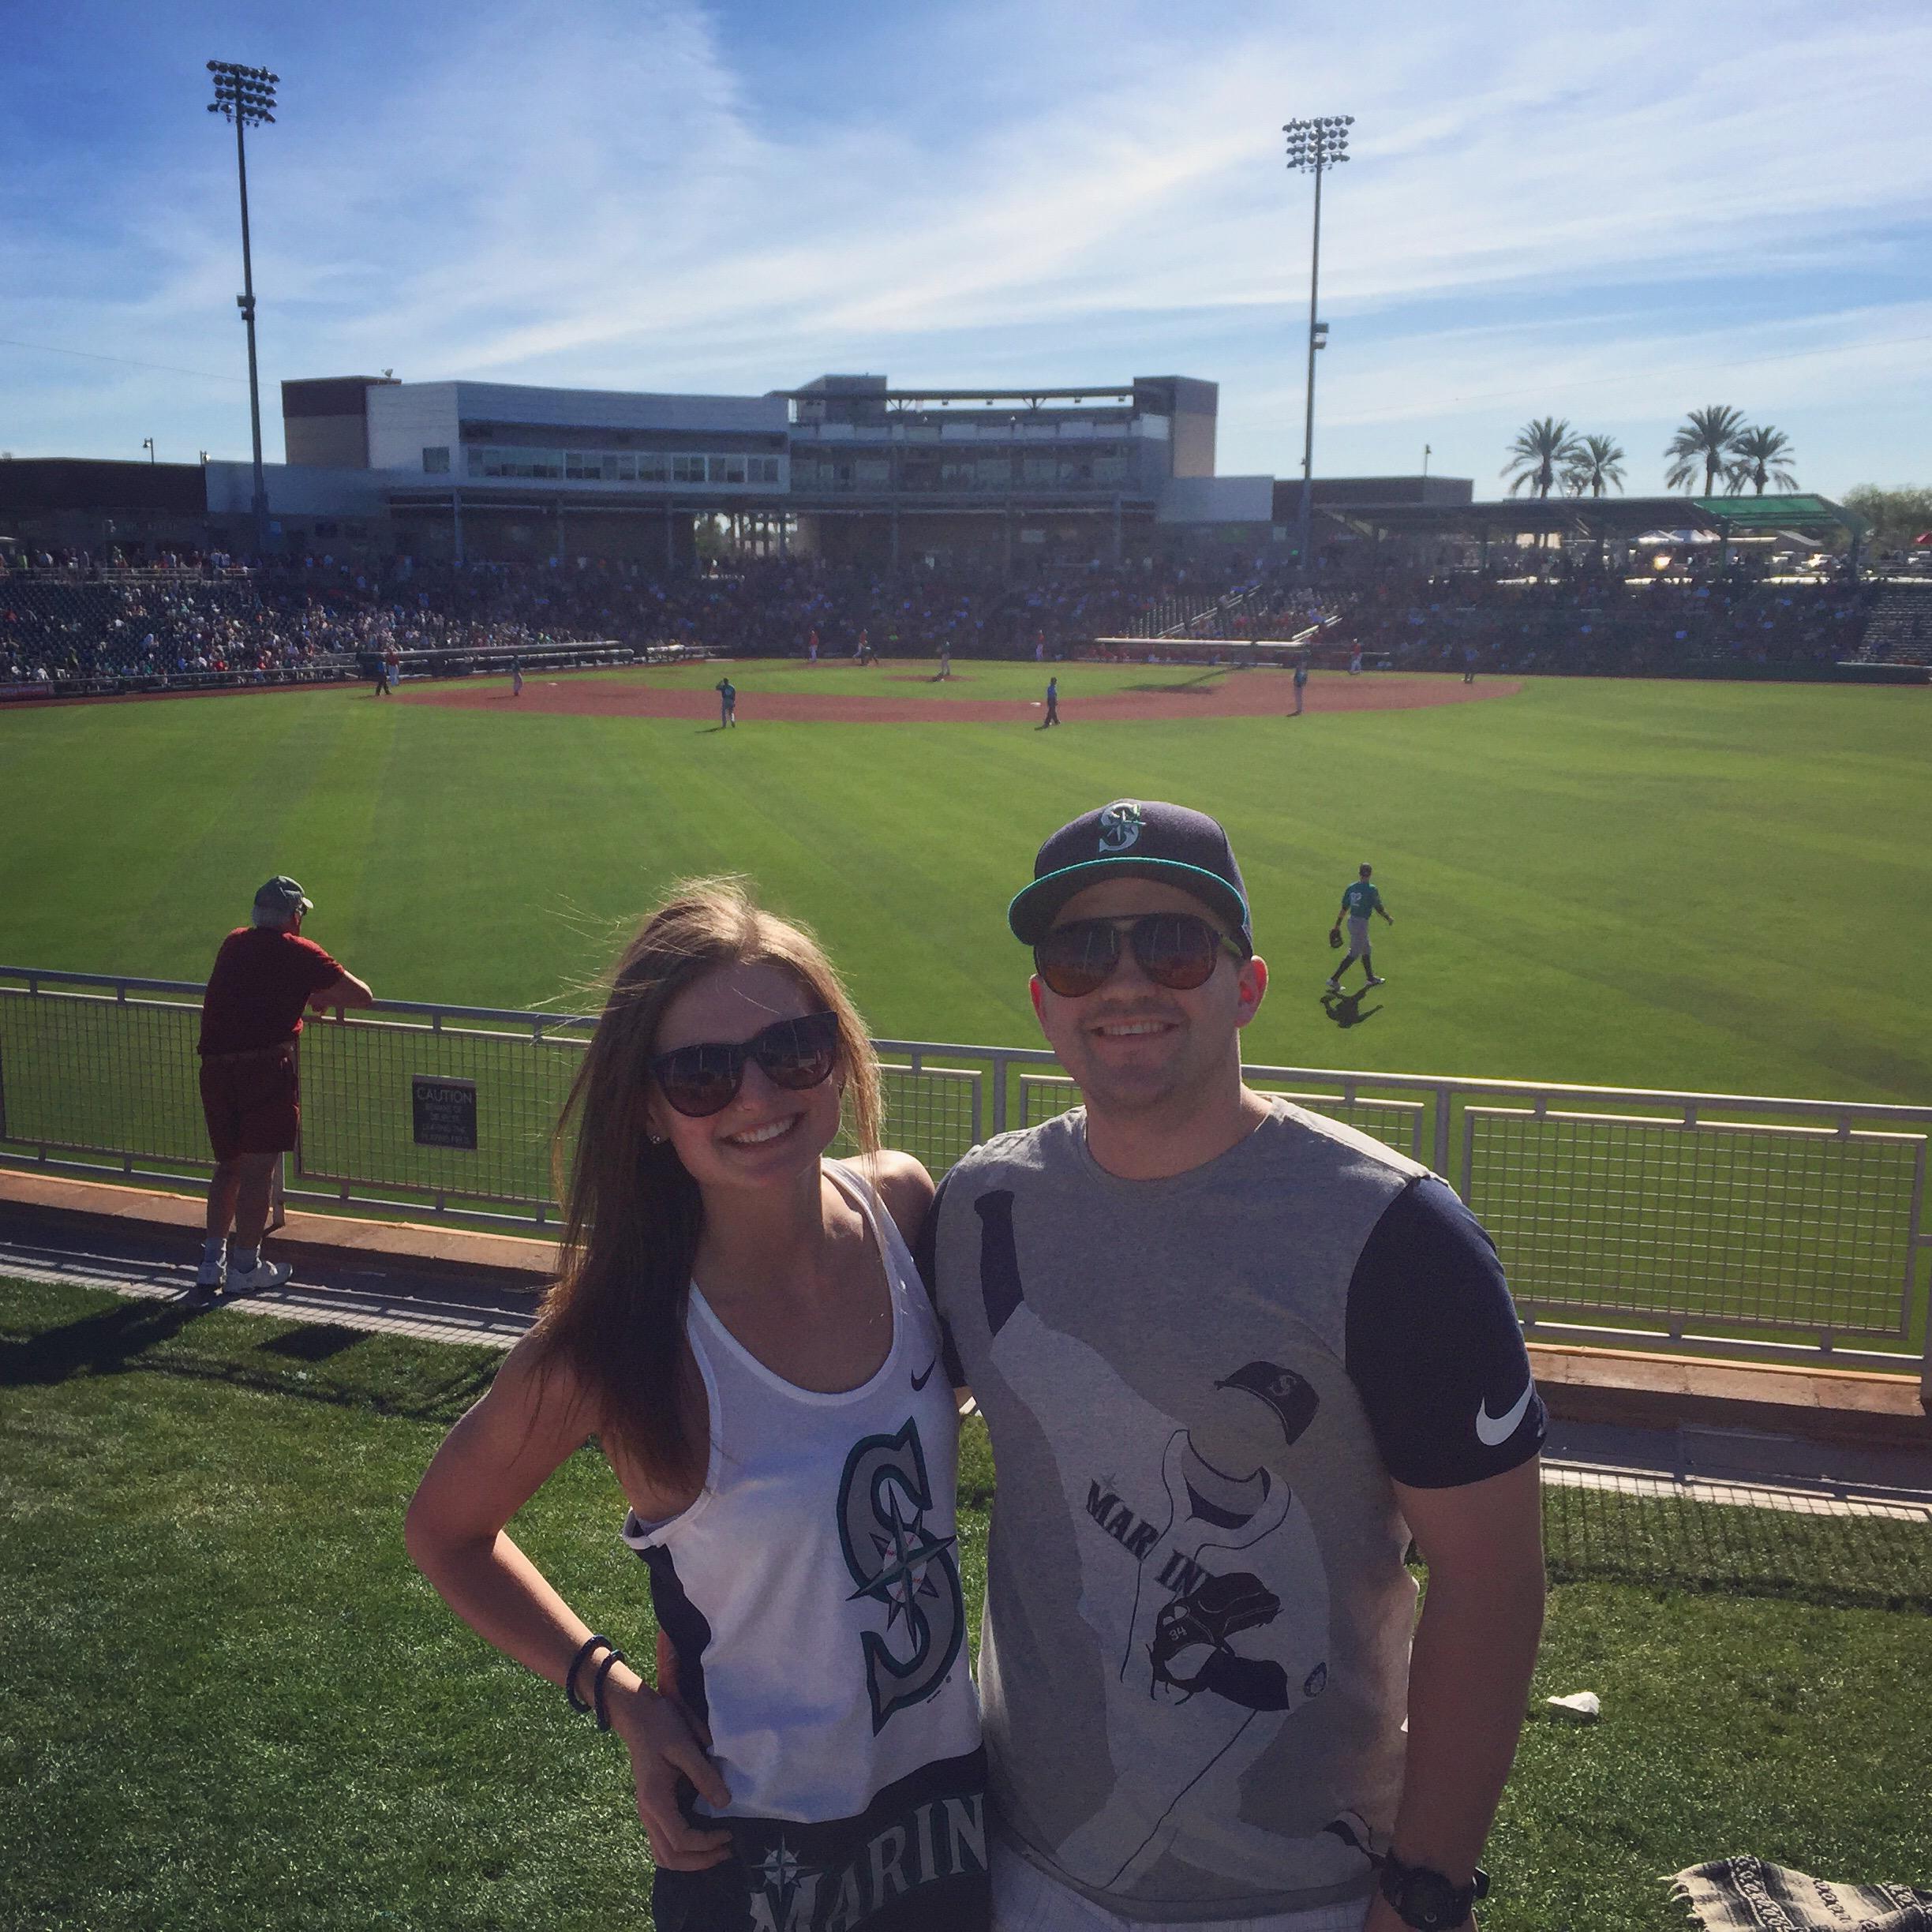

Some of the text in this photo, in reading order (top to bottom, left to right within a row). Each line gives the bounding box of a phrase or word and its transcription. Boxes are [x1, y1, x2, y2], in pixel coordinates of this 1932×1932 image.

[417, 1086, 472, 1104] CAUTION
[1168, 1626, 1188, 1642] 34
[749, 1792, 988, 1932] MARIN
